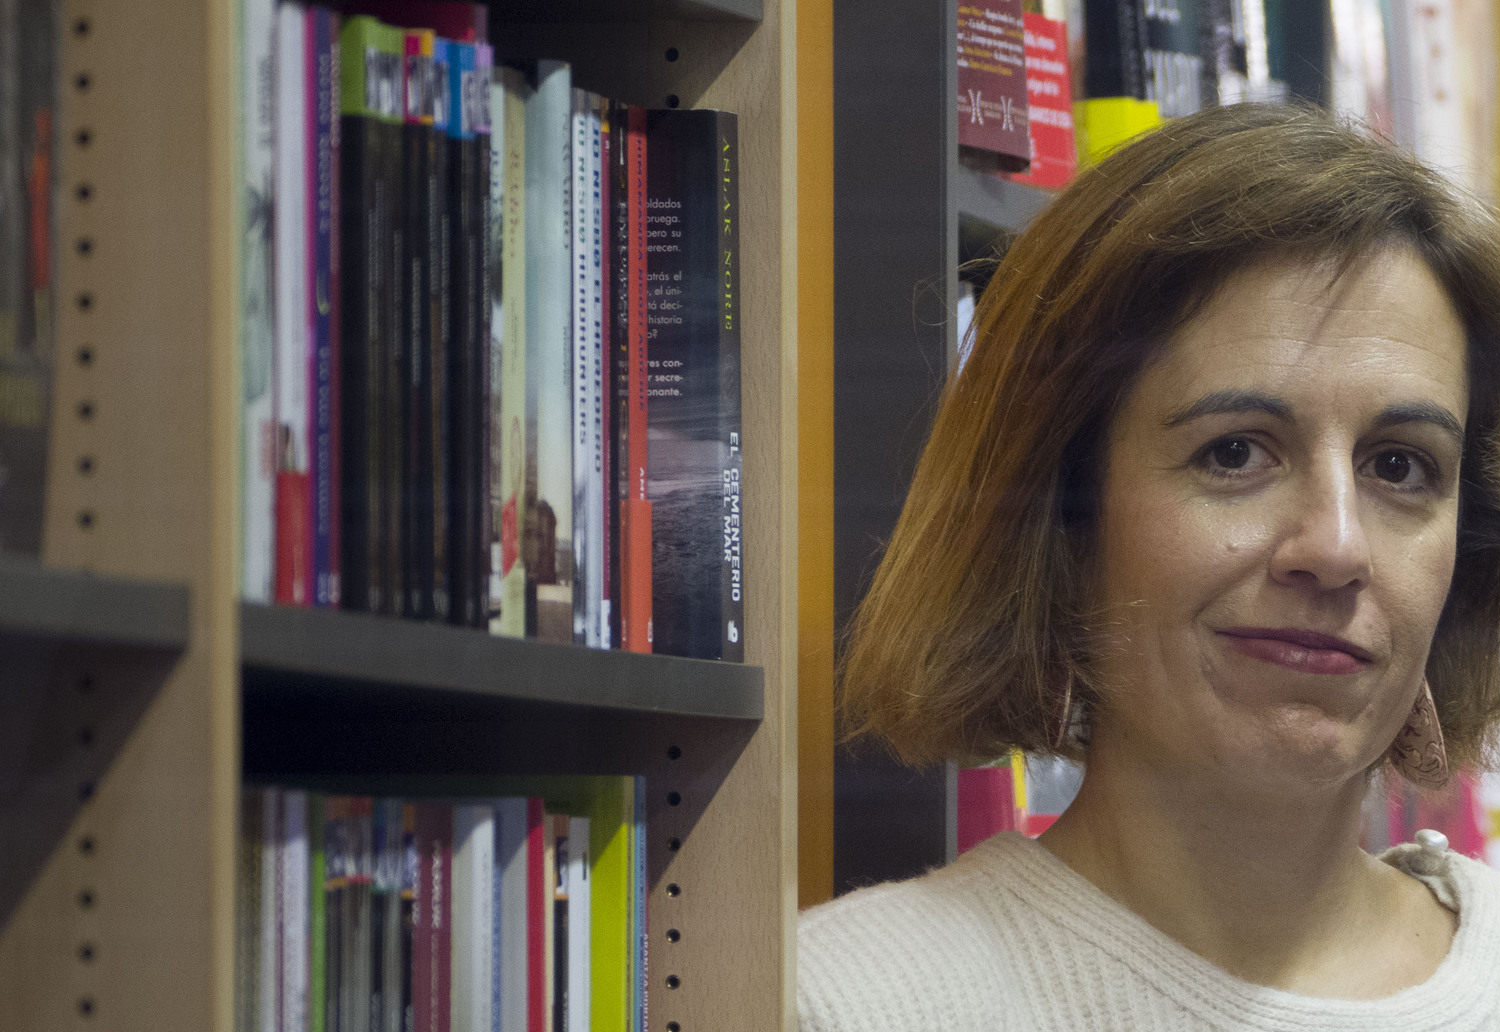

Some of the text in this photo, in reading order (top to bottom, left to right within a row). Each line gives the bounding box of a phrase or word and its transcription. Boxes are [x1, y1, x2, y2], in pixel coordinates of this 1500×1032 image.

[636, 127, 644, 262] HIMAMANDA
[671, 230, 682, 239] su
[722, 137, 733, 330] ASLAK NORE
[673, 271, 682, 281] el
[654, 286, 663, 296] el
[659, 300, 682, 310] deci-
[648, 314, 682, 324] historia
[662, 360, 683, 368] con-
[654, 374, 683, 382] secre-
[722, 469, 732, 562] DEL MAR
[729, 431, 741, 602] EL CEMENTERIO
